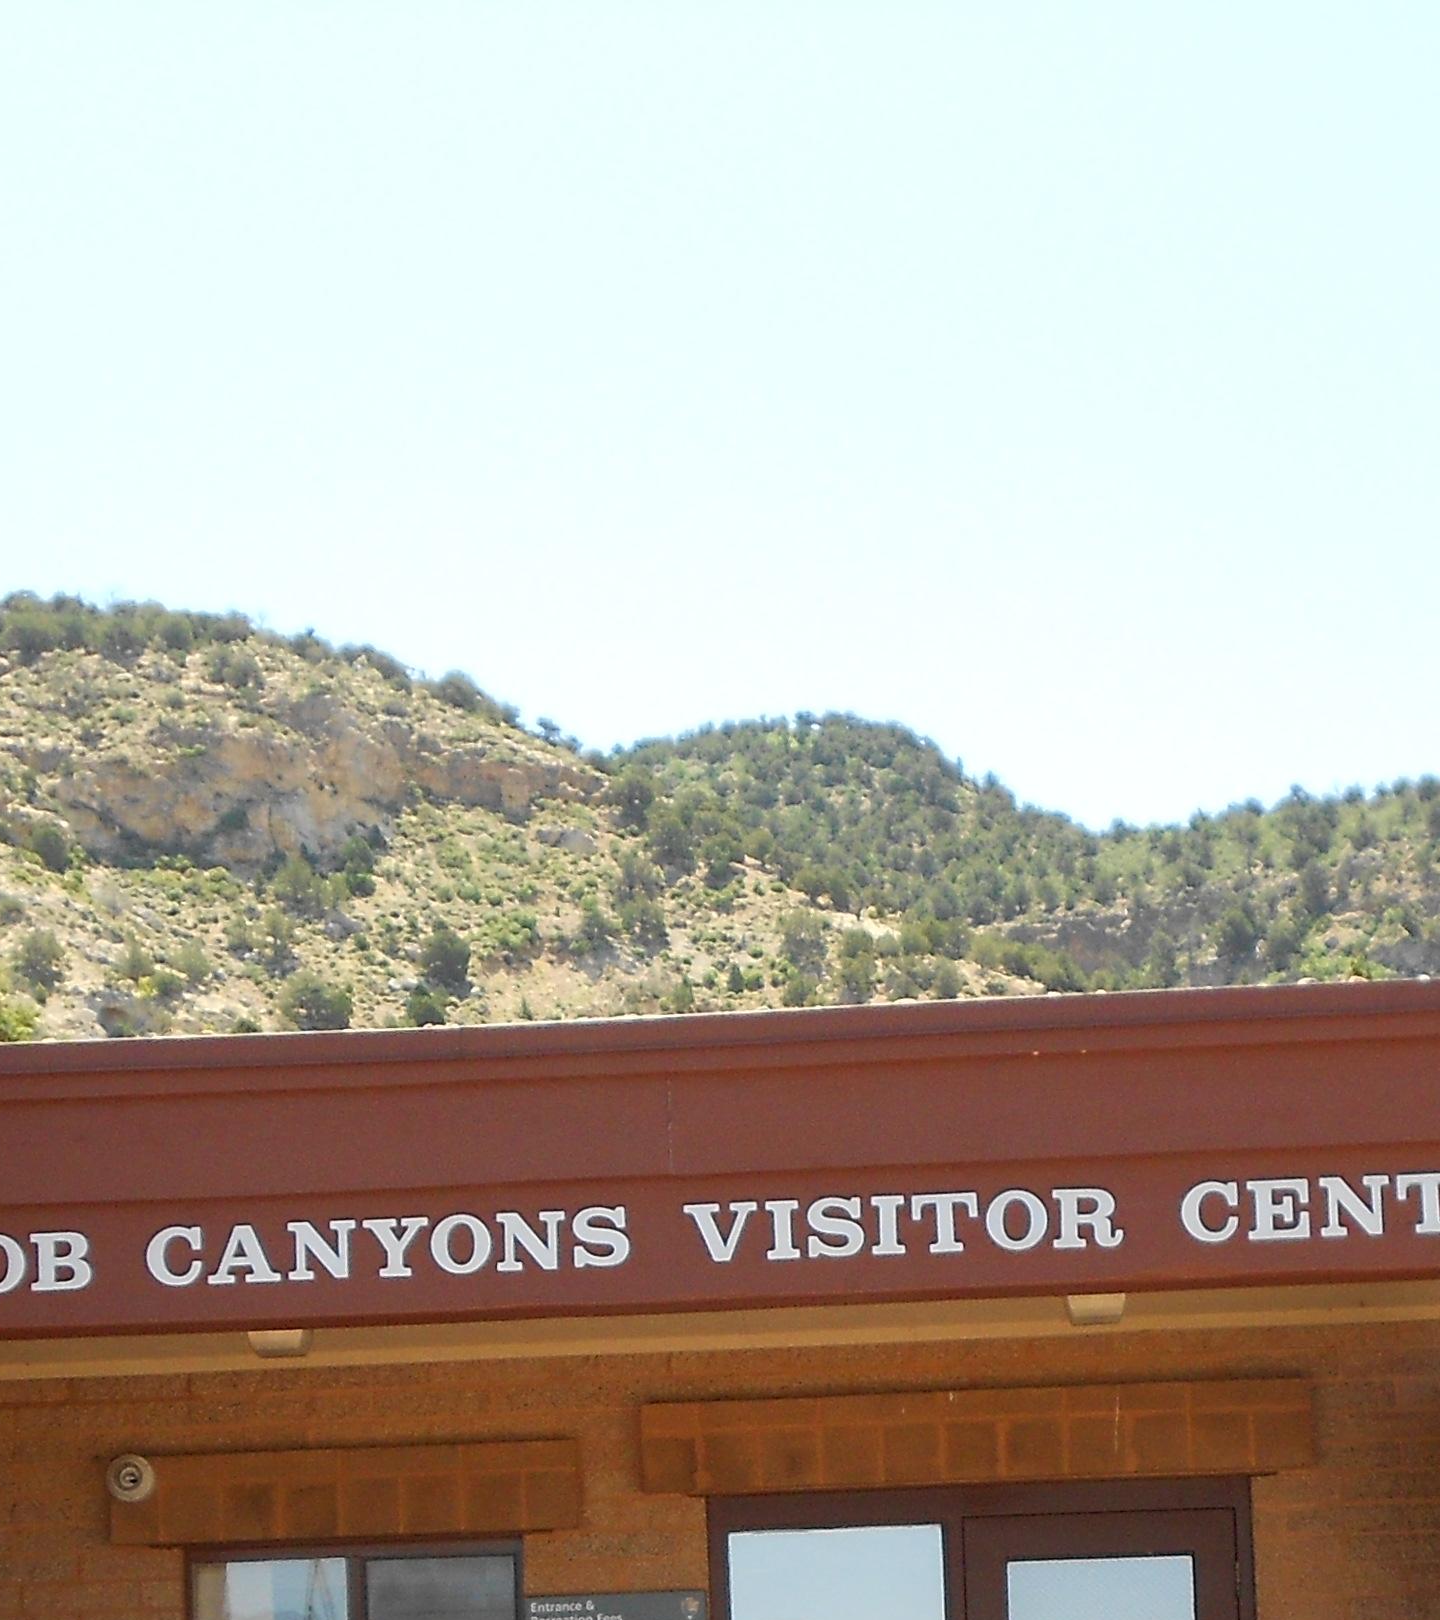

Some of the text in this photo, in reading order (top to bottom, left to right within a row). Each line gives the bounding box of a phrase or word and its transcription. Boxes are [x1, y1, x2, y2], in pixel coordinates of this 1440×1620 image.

[145, 1206, 631, 1285] CANYONS
[683, 1187, 1124, 1263] VISITOR
[530, 1600, 595, 1613] Entrance &
